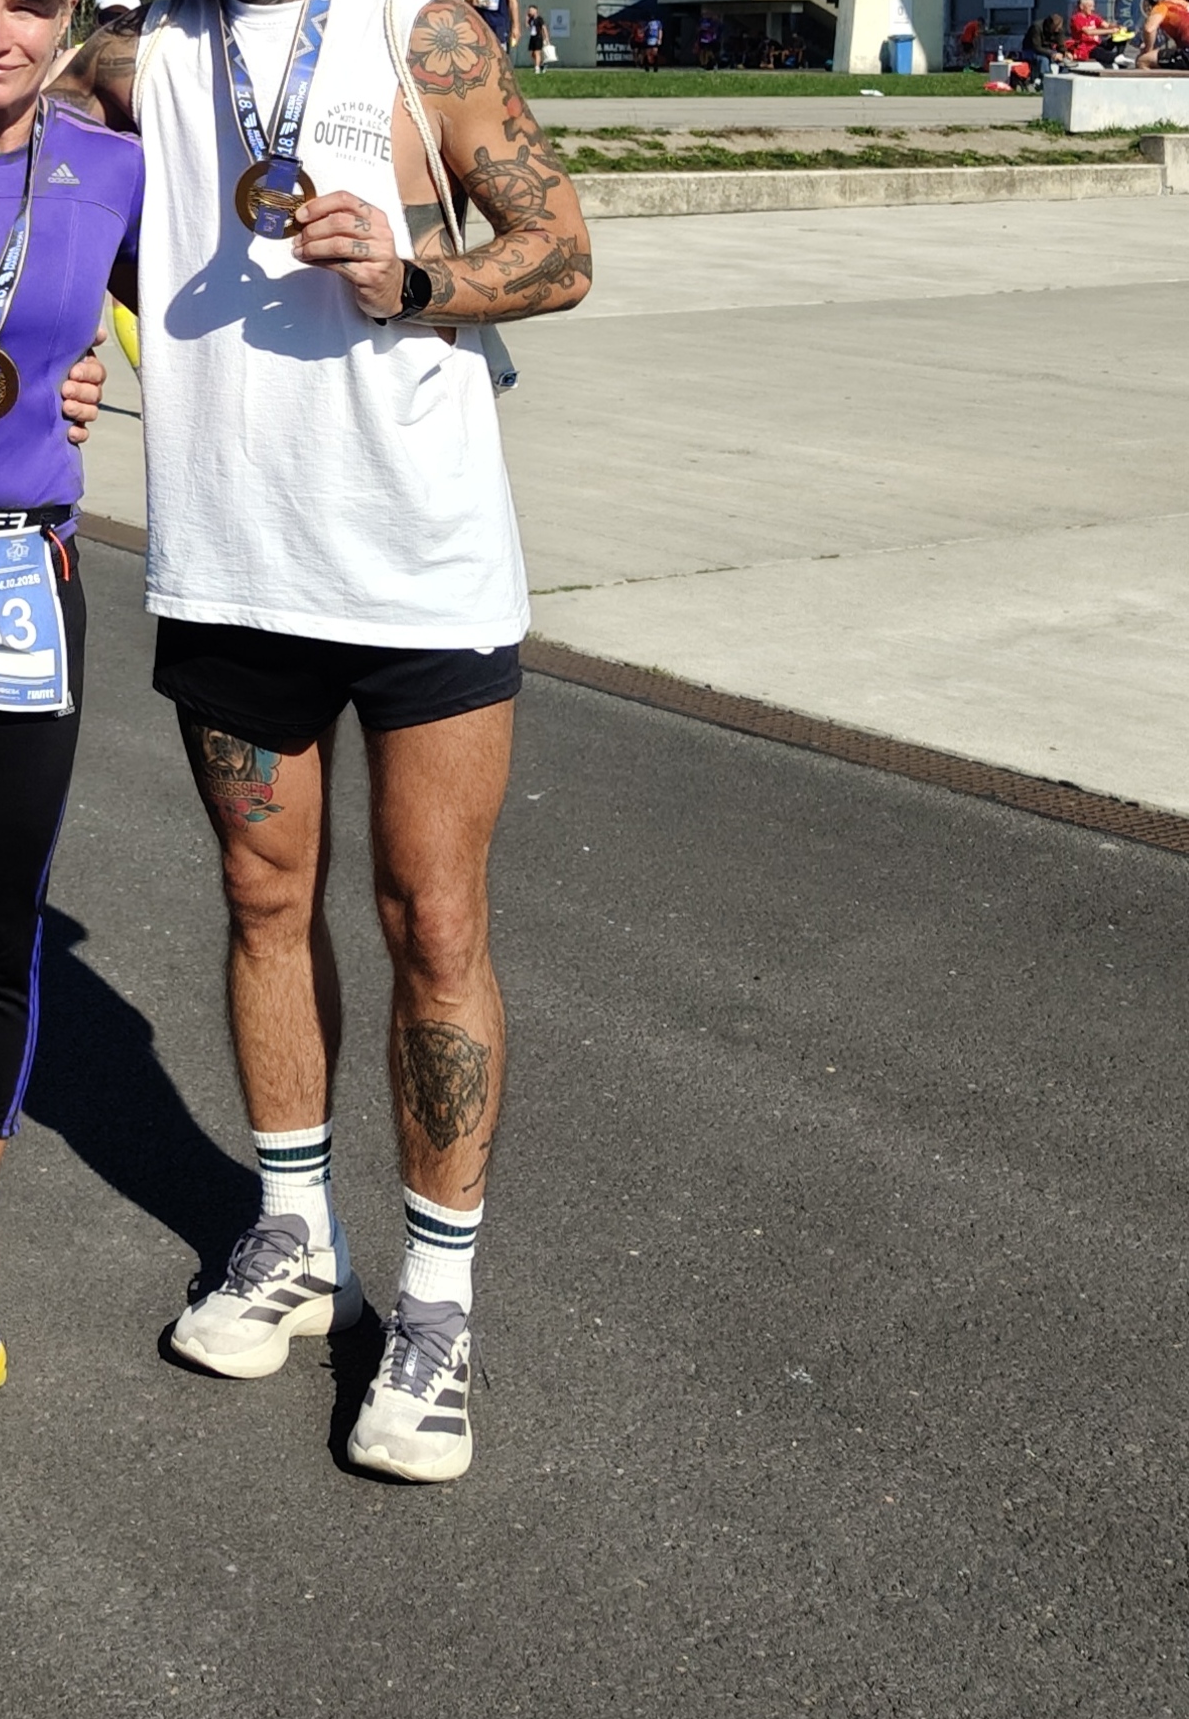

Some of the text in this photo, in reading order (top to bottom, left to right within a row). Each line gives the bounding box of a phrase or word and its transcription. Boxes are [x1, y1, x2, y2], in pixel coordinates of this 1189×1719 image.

[236, 91, 253, 112] 18.
[292, 81, 308, 121] MARATHON
[277, 137, 295, 155] 18.
[314, 121, 393, 163] OUTFITTE
